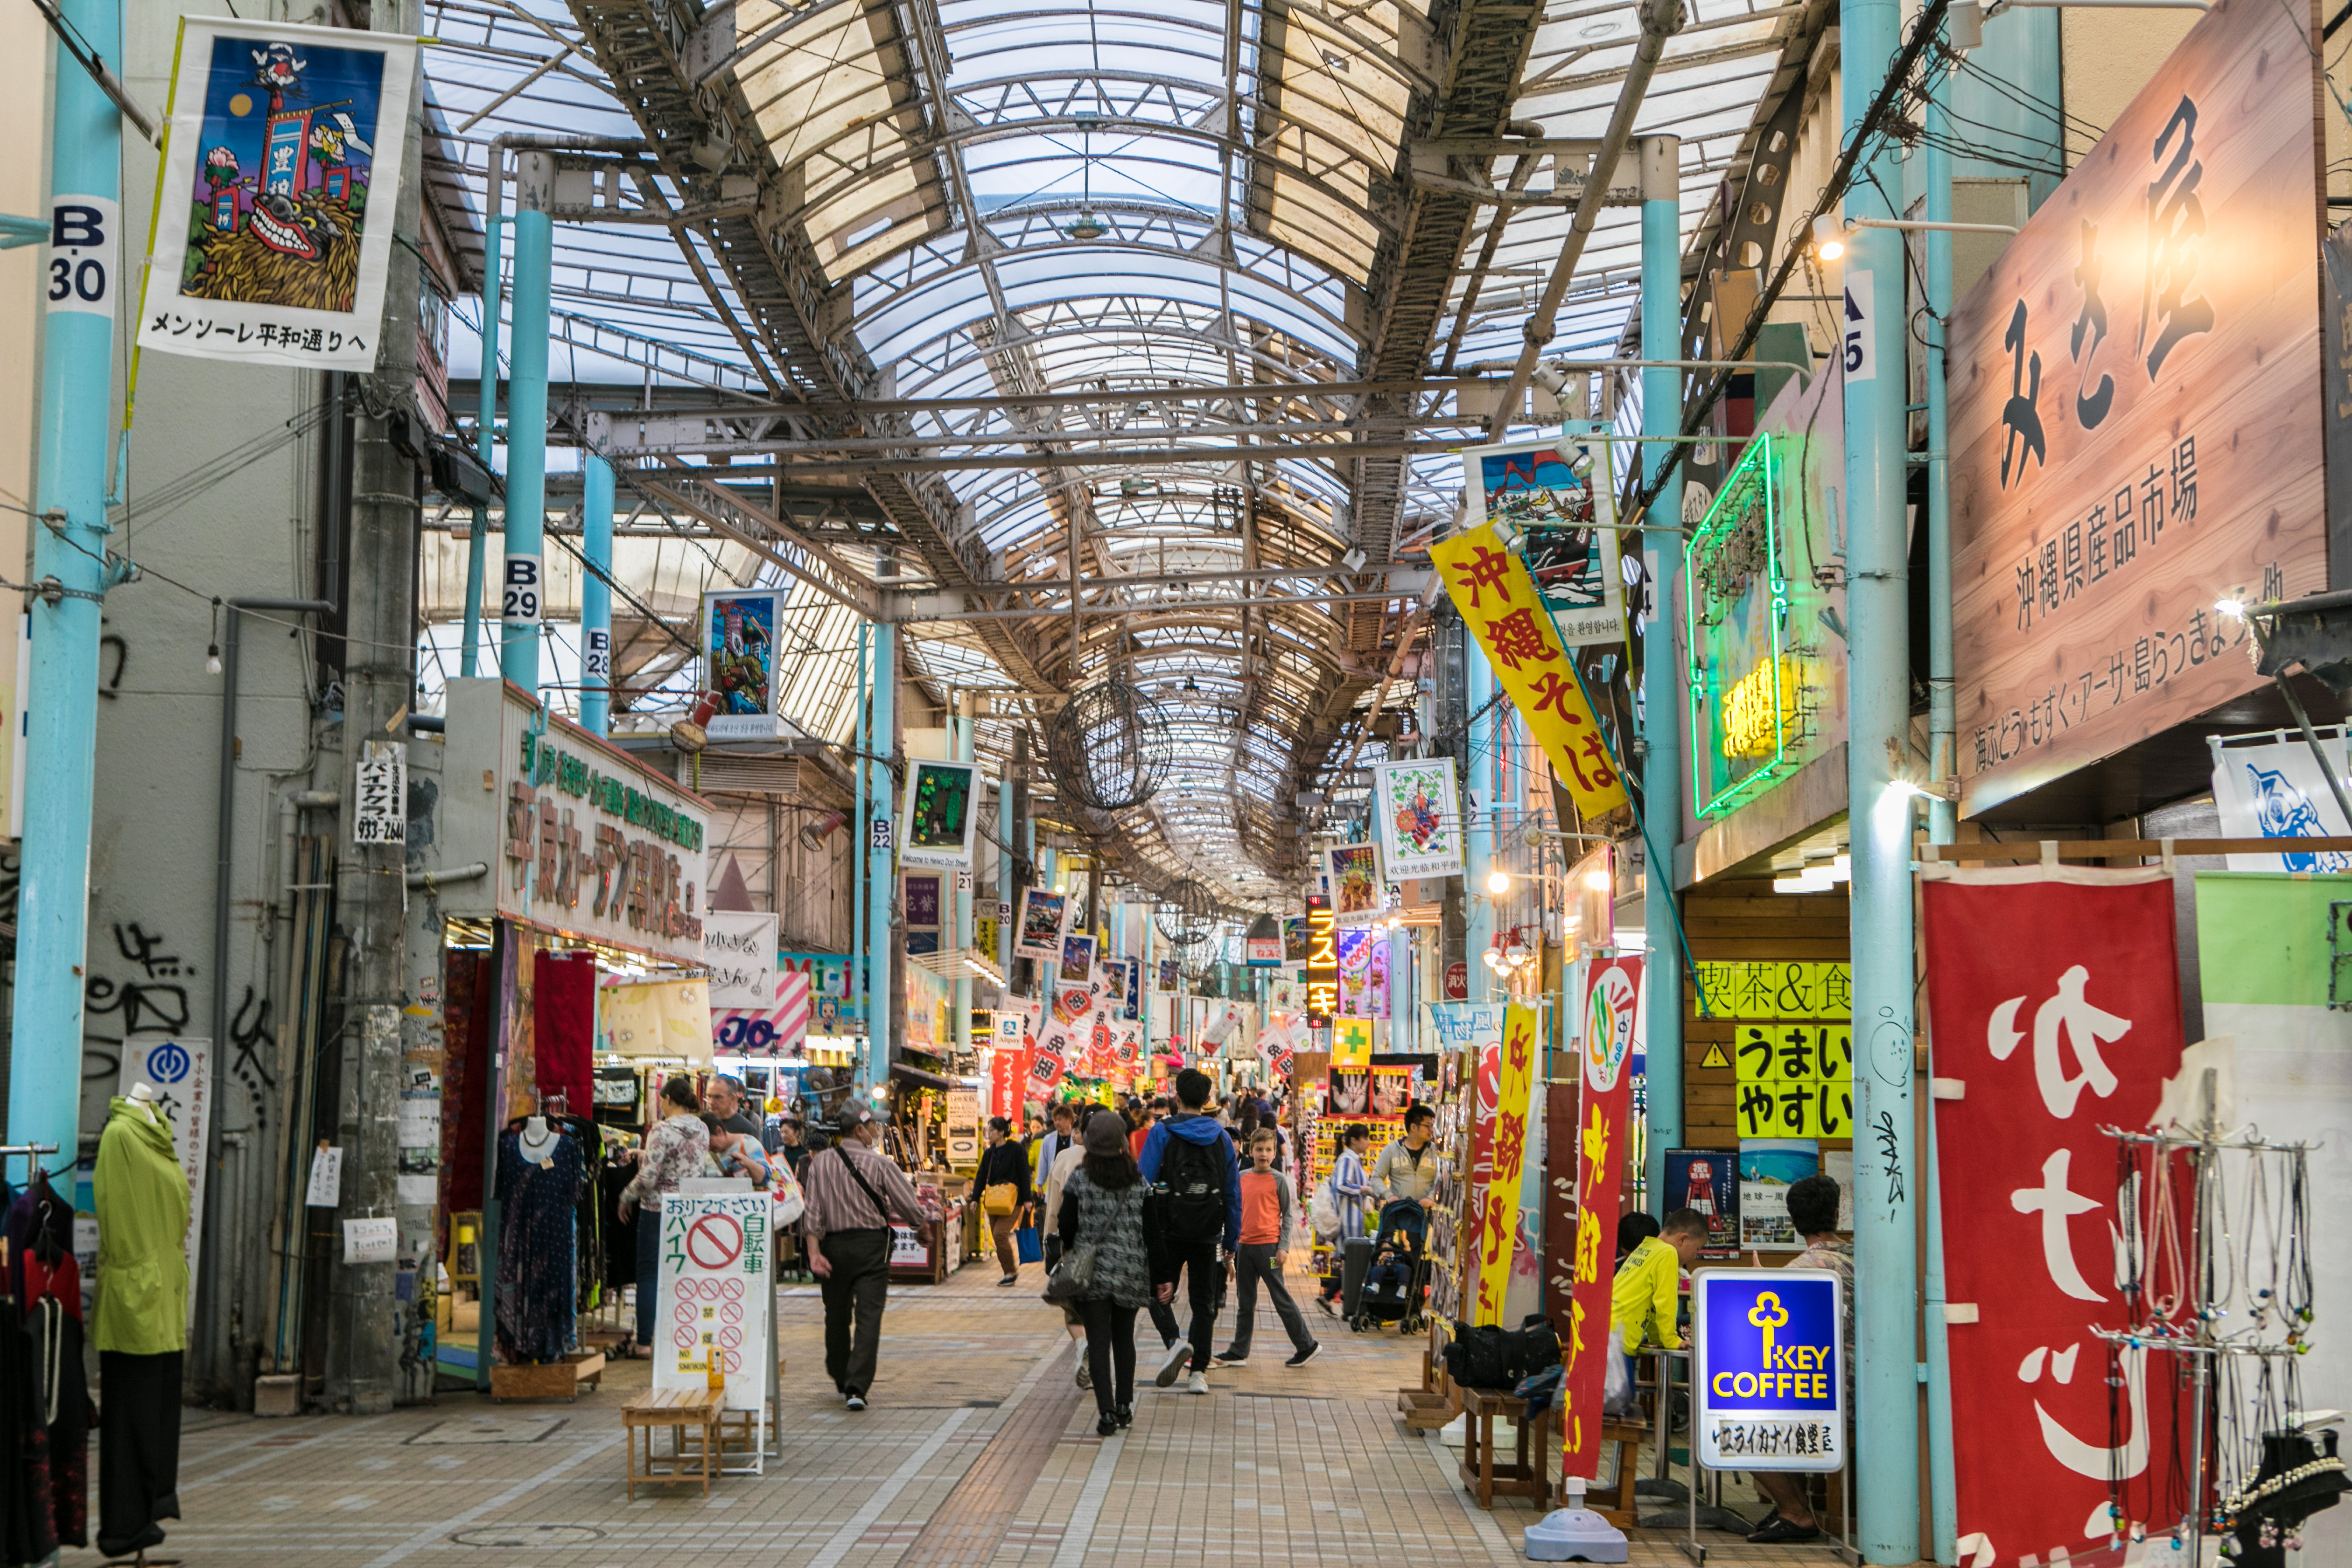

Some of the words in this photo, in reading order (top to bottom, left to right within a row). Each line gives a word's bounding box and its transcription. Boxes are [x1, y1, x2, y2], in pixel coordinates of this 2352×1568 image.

[49, 259, 105, 301] 30
[151, 312, 366, 352] メンソーレ平和通りへ
[1846, 330, 1863, 373] 5
[2016, 435, 2198, 631] 沖縄県産品市場
[504, 592, 537, 617] 29
[1576, 618, 1620, 636] 환영합니다.
[588, 655, 609, 673] 28
[1451, 546, 1618, 792] 沖縄そば
[873, 834, 890, 848] 22
[902, 853, 923, 864] Welcome
[924, 855, 929, 864] to
[955, 859, 968, 868] Street
[1390, 861, 1460, 875] 欢迎光临和平街
[959, 878, 971, 889] 21
[998, 915, 1010, 924] 20
[1448, 974, 1468, 988] 消火
[998, 1036, 1021, 1045] Alipay
[1738, 1028, 1852, 1078] うまい
[1739, 1085, 1853, 1135] やすい
[1743, 1191, 1783, 1202] 地球一周
[666, 1198, 767, 1215] おりて下さい
[665, 1215, 687, 1274] バイク
[743, 1214, 765, 1274] 自転車
[679, 1350, 690, 1358] NO
[1772, 1345, 1831, 1370] KEY
[678, 1363, 707, 1371] SMOKIN
[1712, 1372, 1828, 1399] COFFEE
